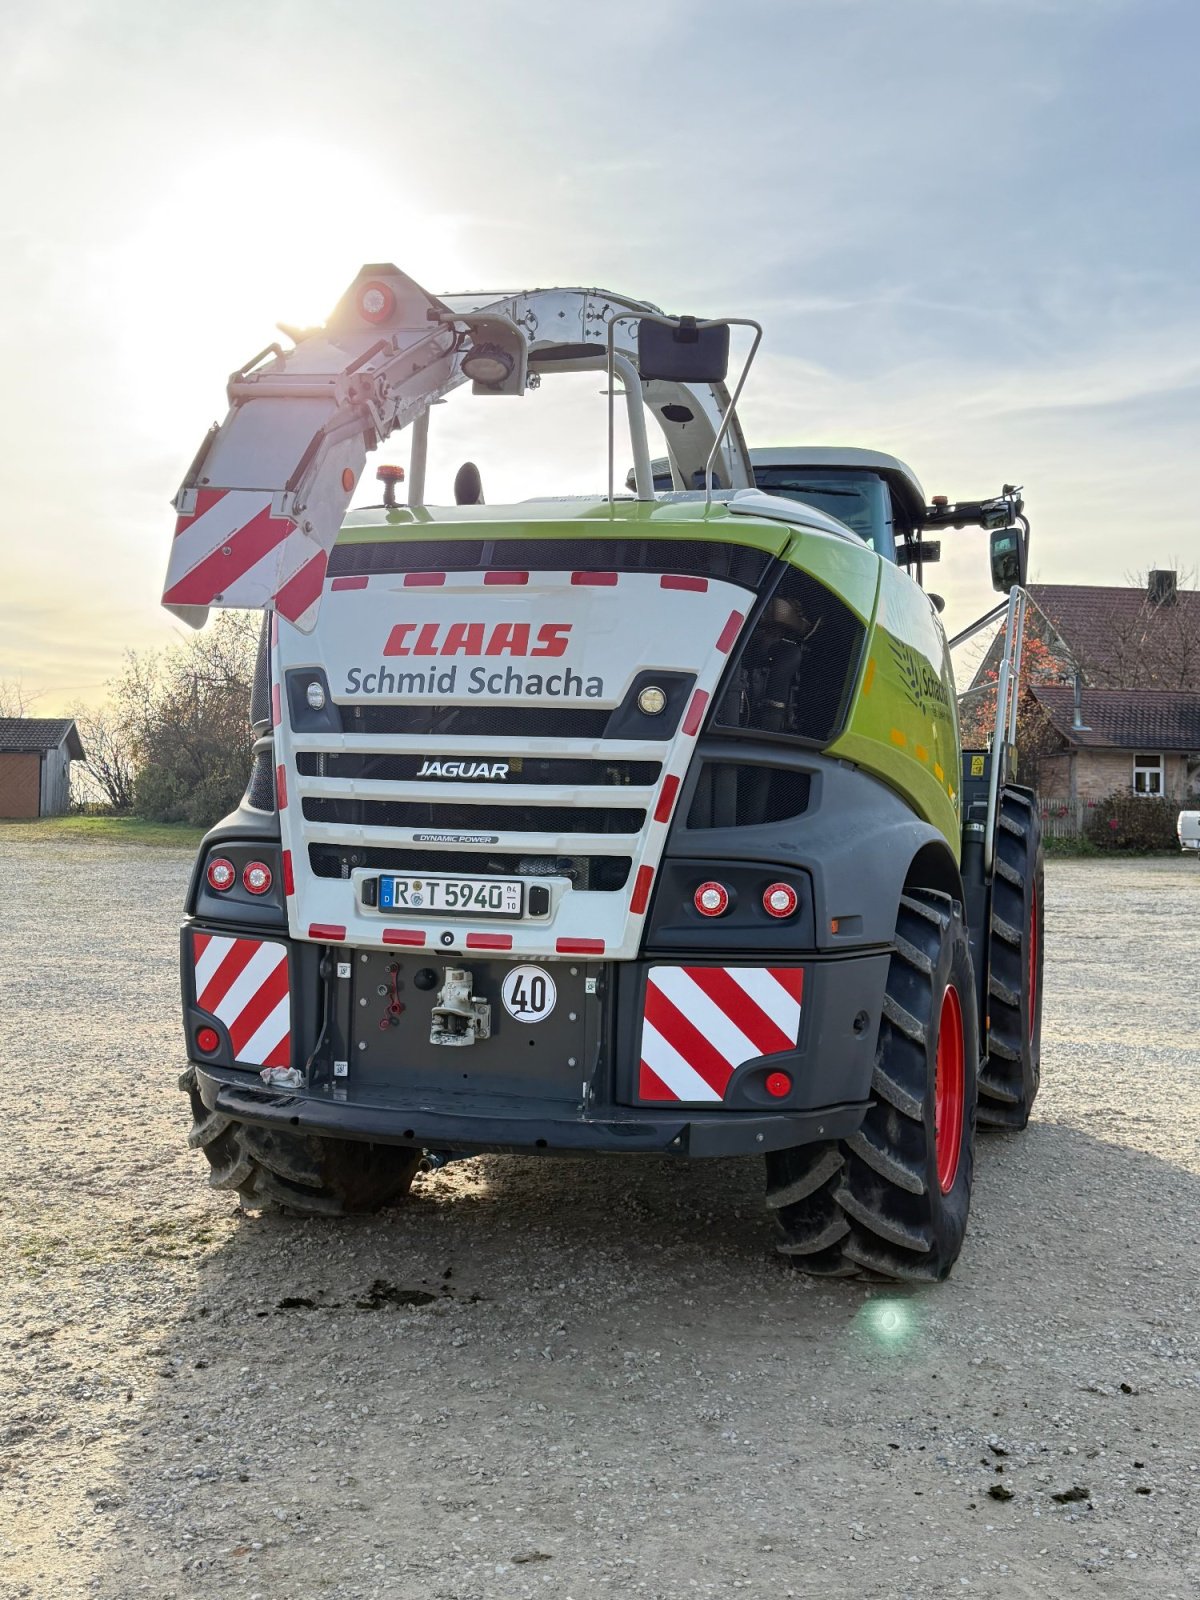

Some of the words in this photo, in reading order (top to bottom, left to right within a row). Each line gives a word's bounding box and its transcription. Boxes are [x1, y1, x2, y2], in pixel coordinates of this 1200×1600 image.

[382, 623, 573, 657] CLAAS
[345, 665, 457, 694] Schmid
[467, 665, 604, 698] Schacha
[416, 761, 509, 779] JAGUAR
[420, 834, 458, 843] DYNAMIC
[458, 835, 492, 844] POWER
[384, 895, 390, 903] D
[394, 881, 409, 905] R
[426, 881, 440, 906] T
[445, 883, 502, 909] 5940
[506, 902, 517, 910] 10
[511, 975, 546, 1013] 40
